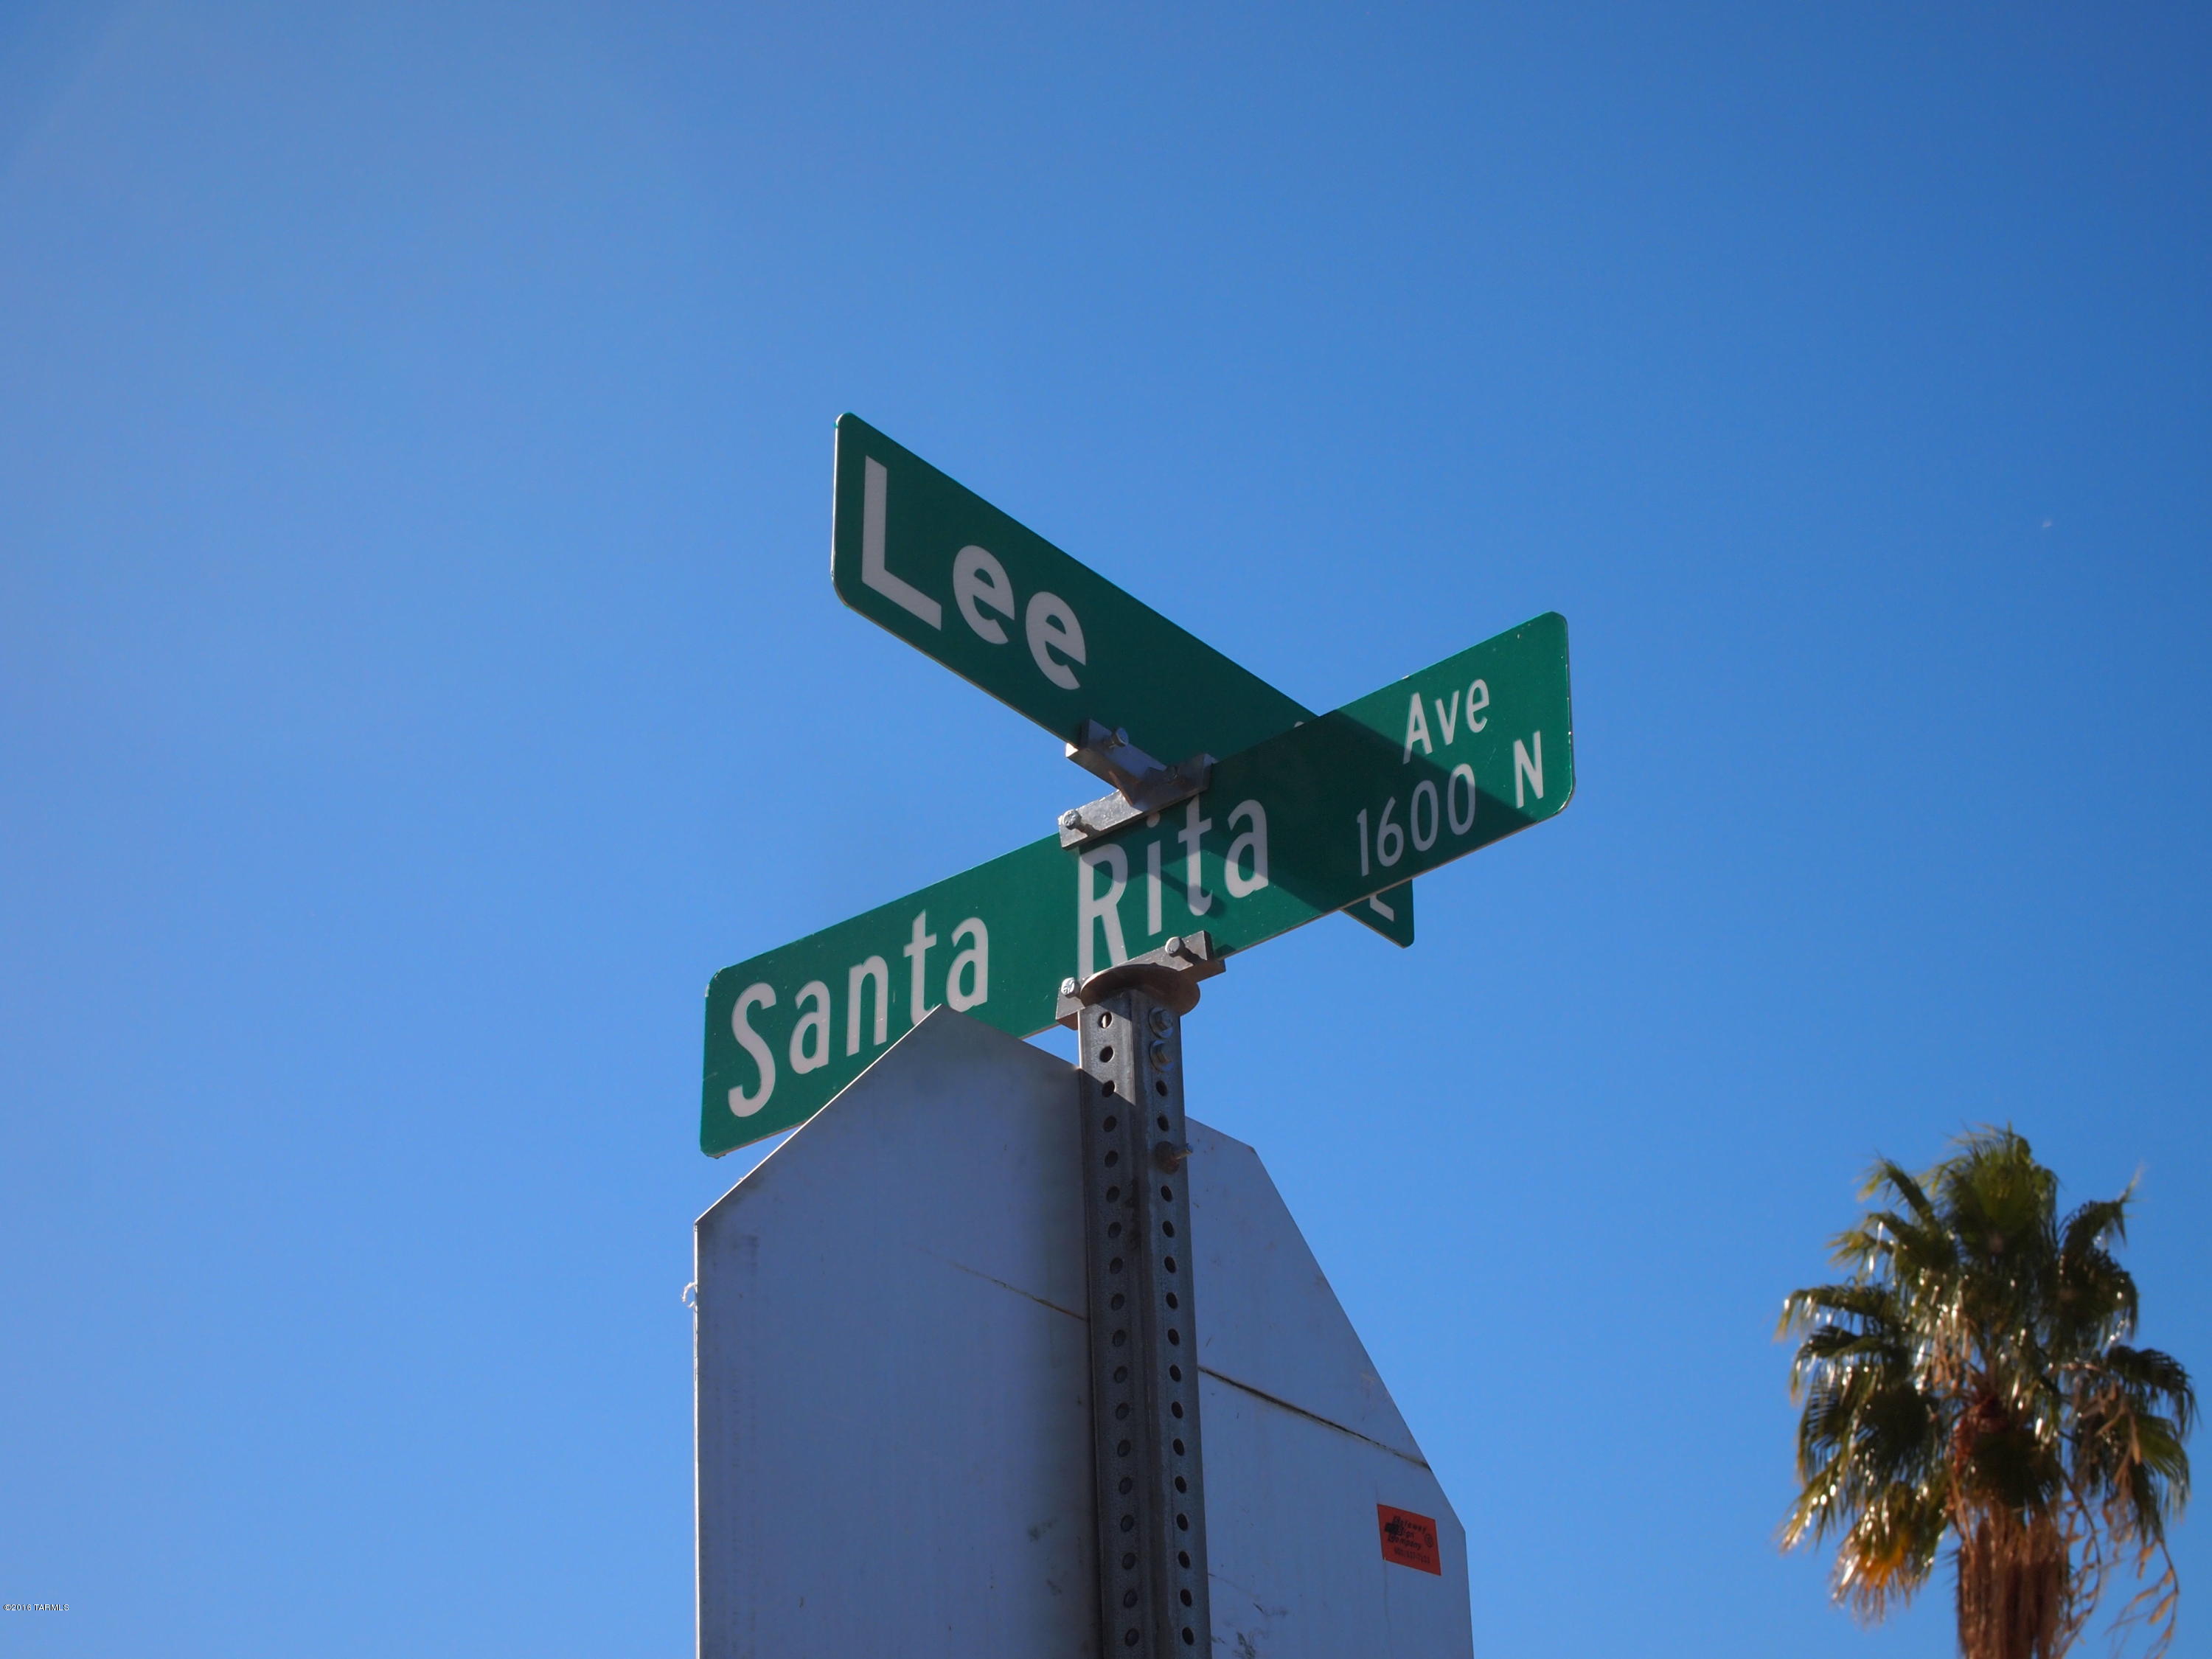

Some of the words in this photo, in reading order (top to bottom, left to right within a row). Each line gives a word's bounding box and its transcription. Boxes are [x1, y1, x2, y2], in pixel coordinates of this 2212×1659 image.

[862, 455, 1086, 690] Lee
[1356, 762, 1476, 877] 1600
[1512, 730, 1545, 809] N
[1403, 678, 1490, 765] Ave
[727, 909, 990, 1117] Santa
[1078, 794, 1269, 979] Rita
